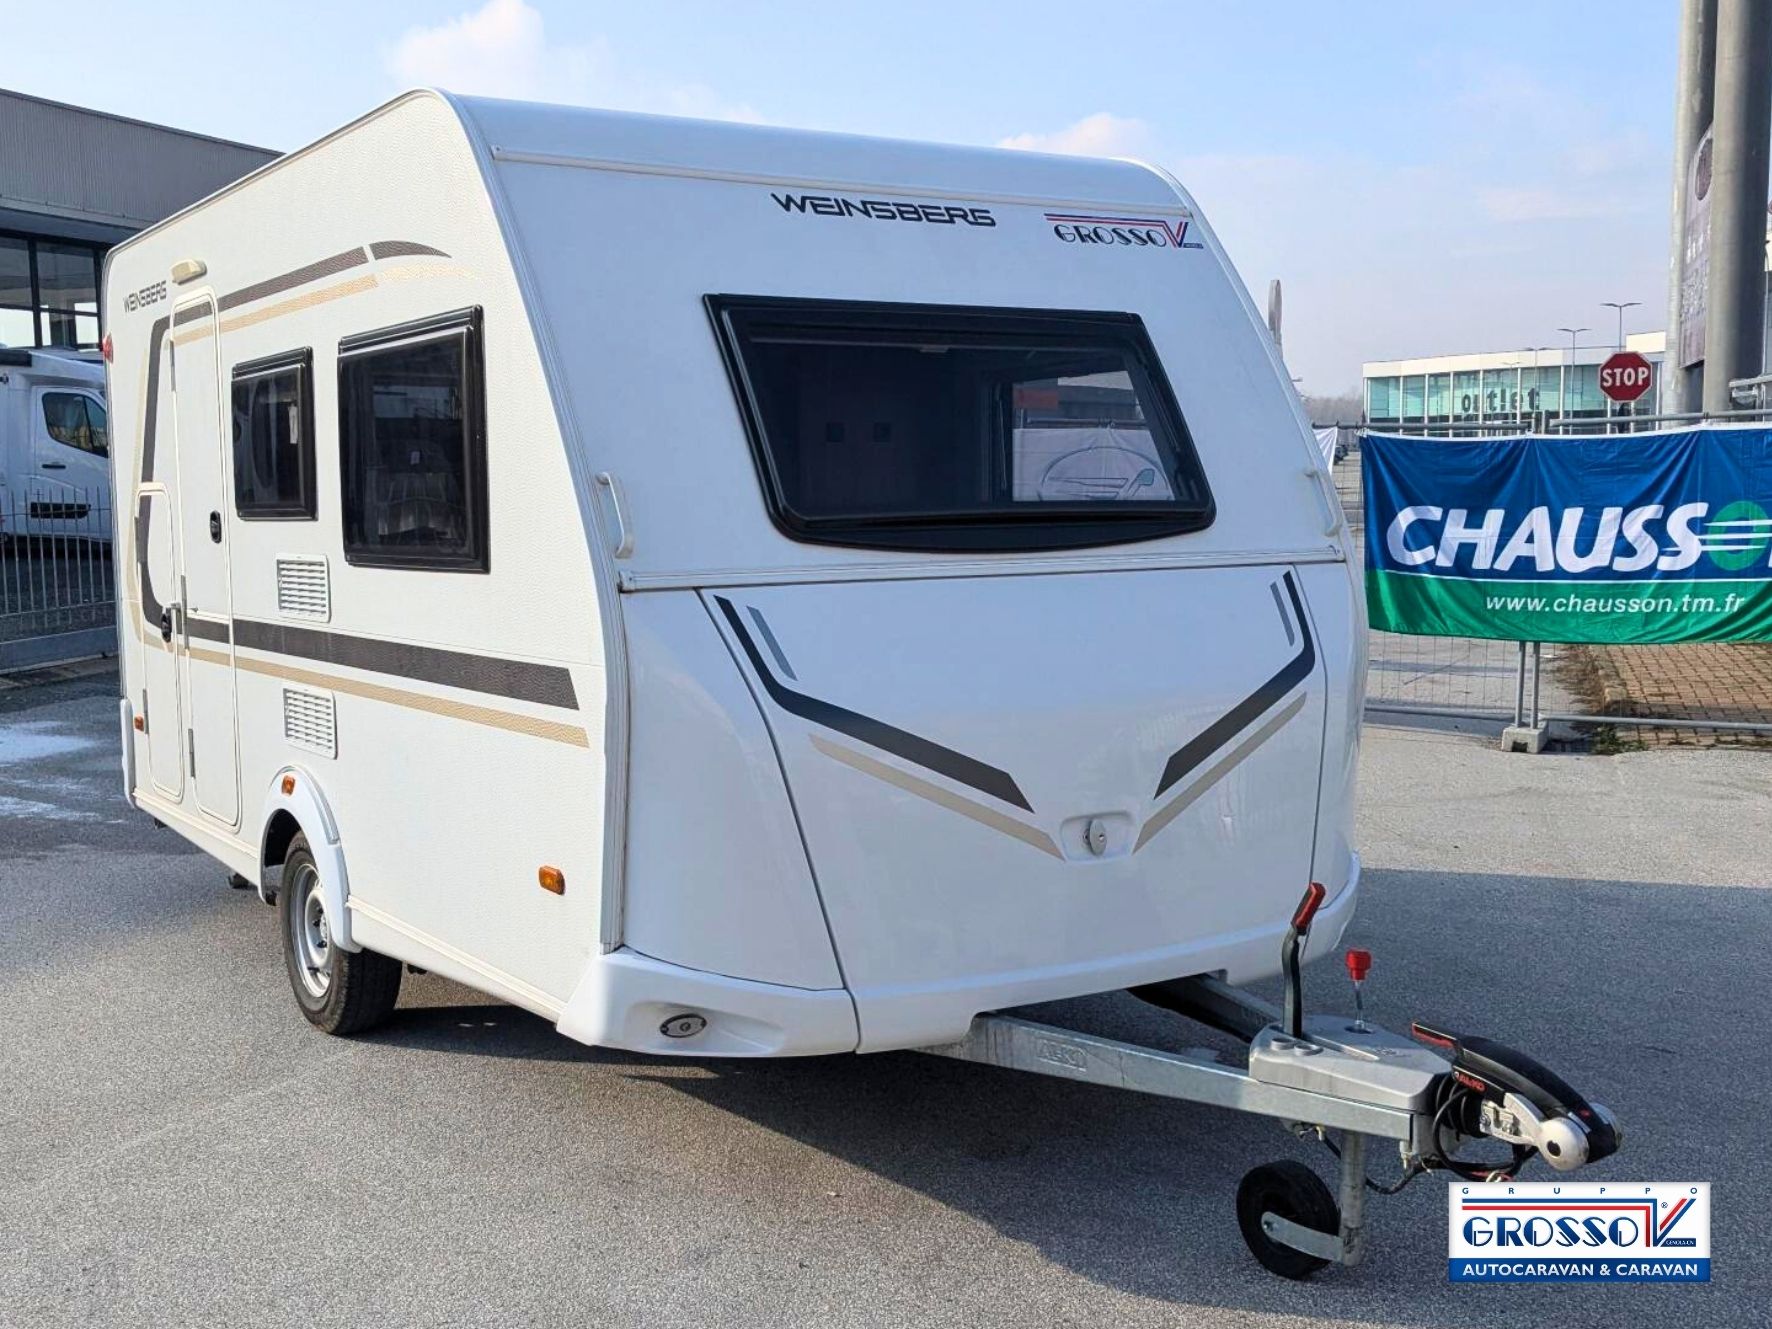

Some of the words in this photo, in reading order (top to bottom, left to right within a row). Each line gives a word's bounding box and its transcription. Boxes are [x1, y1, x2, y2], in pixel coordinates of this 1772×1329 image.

[770, 192, 997, 228] WEINSBERG
[1053, 223, 1167, 248] GROSSO
[1602, 366, 1649, 387] STOP
[1386, 499, 1772, 574] CHAUSSO
[1485, 593, 1745, 613] www.chausson.tm.fr
